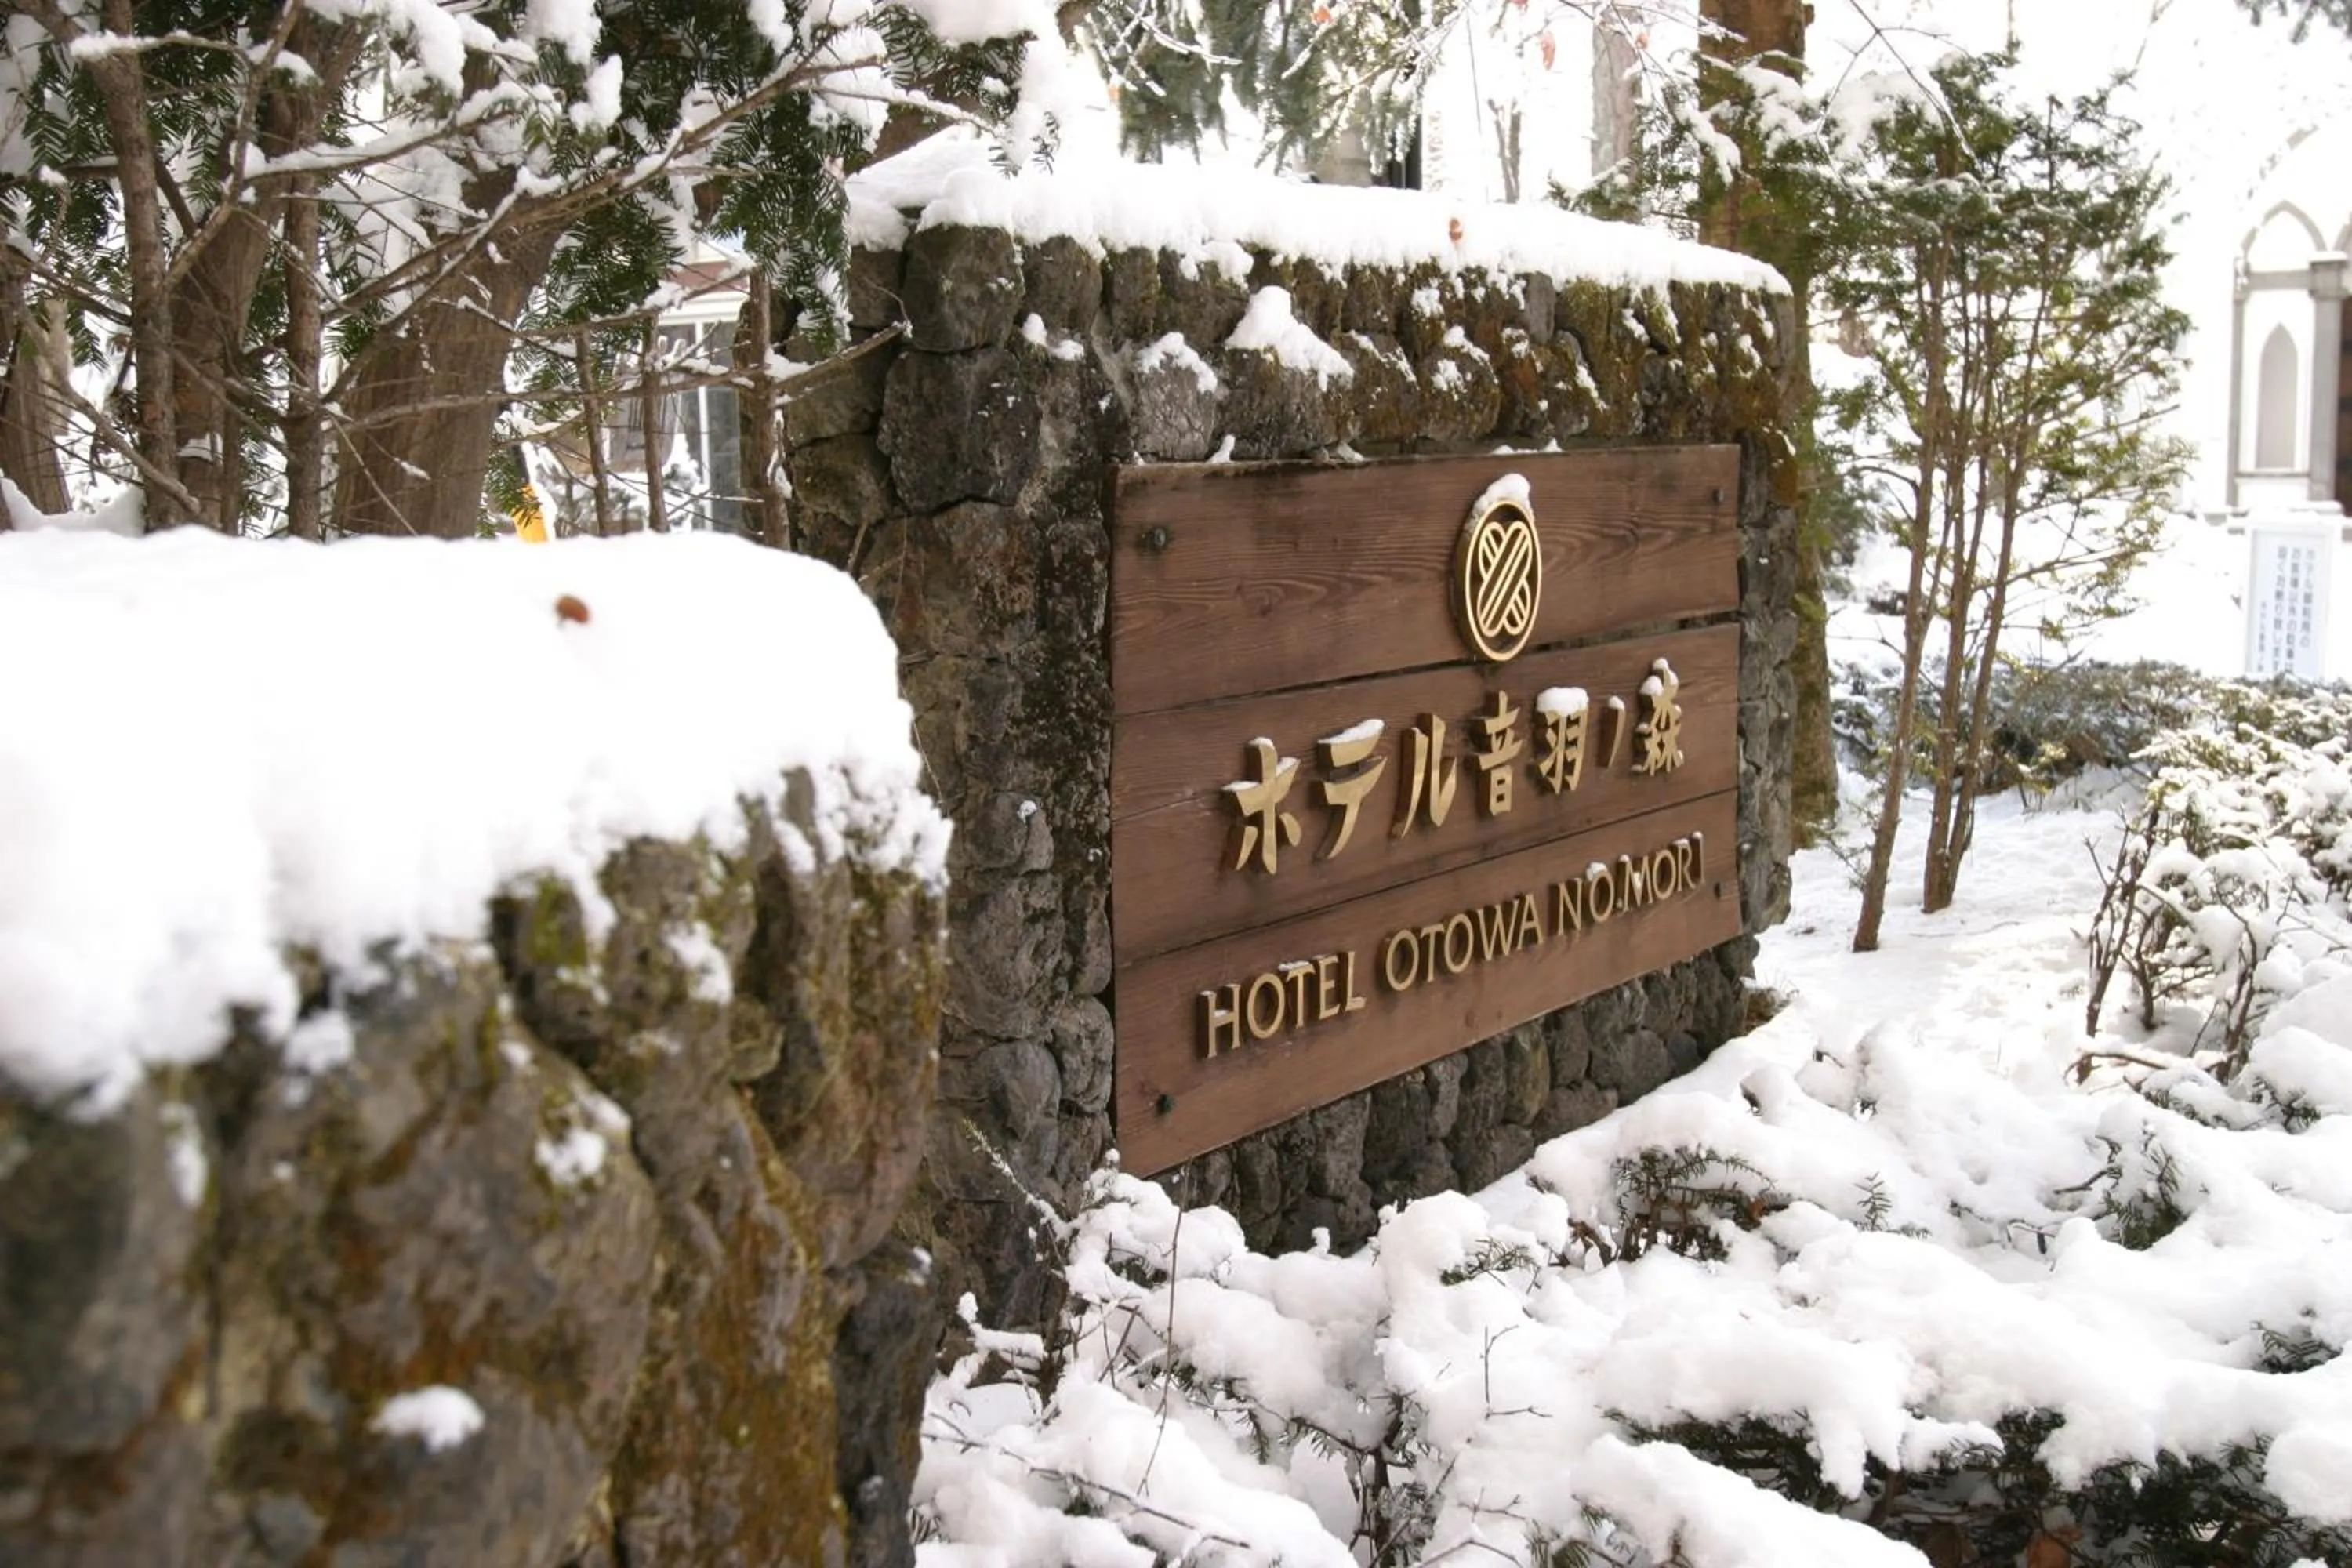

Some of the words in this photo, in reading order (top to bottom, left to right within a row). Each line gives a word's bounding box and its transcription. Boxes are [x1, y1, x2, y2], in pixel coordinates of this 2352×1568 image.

[1221, 659, 1685, 876] ホテル音羽ノ森
[1202, 951, 1367, 1058] HOTEL
[1385, 895, 1543, 992] OTOWA
